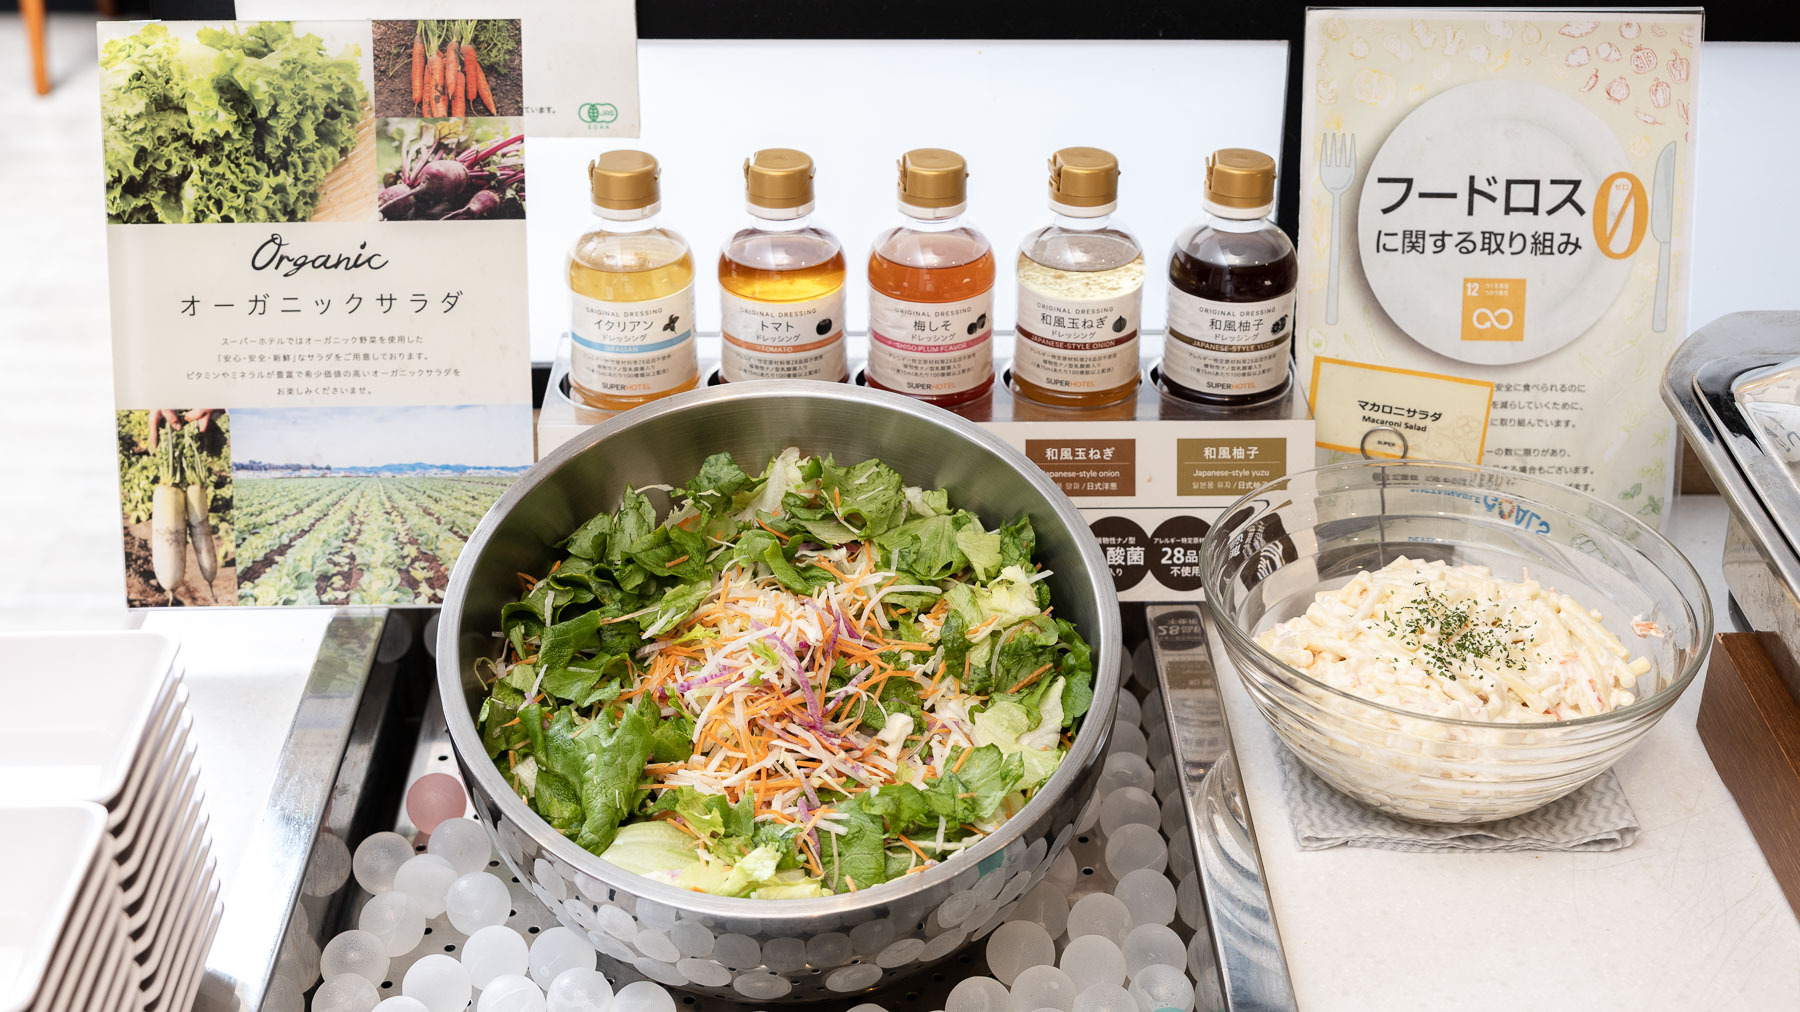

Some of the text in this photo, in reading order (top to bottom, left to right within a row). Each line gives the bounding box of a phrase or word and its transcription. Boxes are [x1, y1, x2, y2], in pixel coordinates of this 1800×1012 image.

[1376, 174, 1586, 218] フードロス
[1375, 229, 1583, 257] に関する取り組み
[251, 232, 389, 278] Organic
[1466, 282, 1479, 297] 12
[180, 289, 464, 317] オーガニックサラダ
[1036, 302, 1114, 315] ORIGINAL DRESSING
[585, 306, 663, 318] ORIGINAL DRESSING
[739, 306, 817, 318] ORIGINAL DRESSING
[894, 306, 972, 317] ORIGINAL DRESSING
[1199, 306, 1276, 317] ORIGINAL DRESSING
[593, 319, 654, 333] イタリアン
[760, 320, 794, 332] トマト
[913, 320, 952, 332] 梅しそ
[1040, 312, 1108, 330] 和風玉ねぎ
[1209, 318, 1264, 332] 和風柚子
[602, 333, 647, 343] ドレッシング
[756, 333, 801, 343] ドレッシング
[911, 332, 957, 342] ドレッシング
[1051, 330, 1096, 340] ドレッシング
[1214, 332, 1260, 342] ドレッシング
[1030, 334, 1116, 350] JAPANESE-STYLE ONION
[1191, 339, 1256, 352] JAPANESE-STYLE
[760, 345, 793, 353] TOMATO
[1495, 383, 1587, 393] 安全に食べられるのに
[1357, 399, 1443, 422] マカロニサラダ
[1362, 415, 1427, 432] Macaroni Salad
[1045, 446, 1115, 461] 和風玉ねぎ
[1203, 446, 1259, 460] 和風柚子
[1043, 469, 1120, 479] apanese-style onion
[1192, 468, 1270, 478] Japanese-style yuzu
[1106, 546, 1145, 566] 酸菌
[1160, 547, 1201, 565] 28品
[1170, 566, 1201, 577] 不使用
